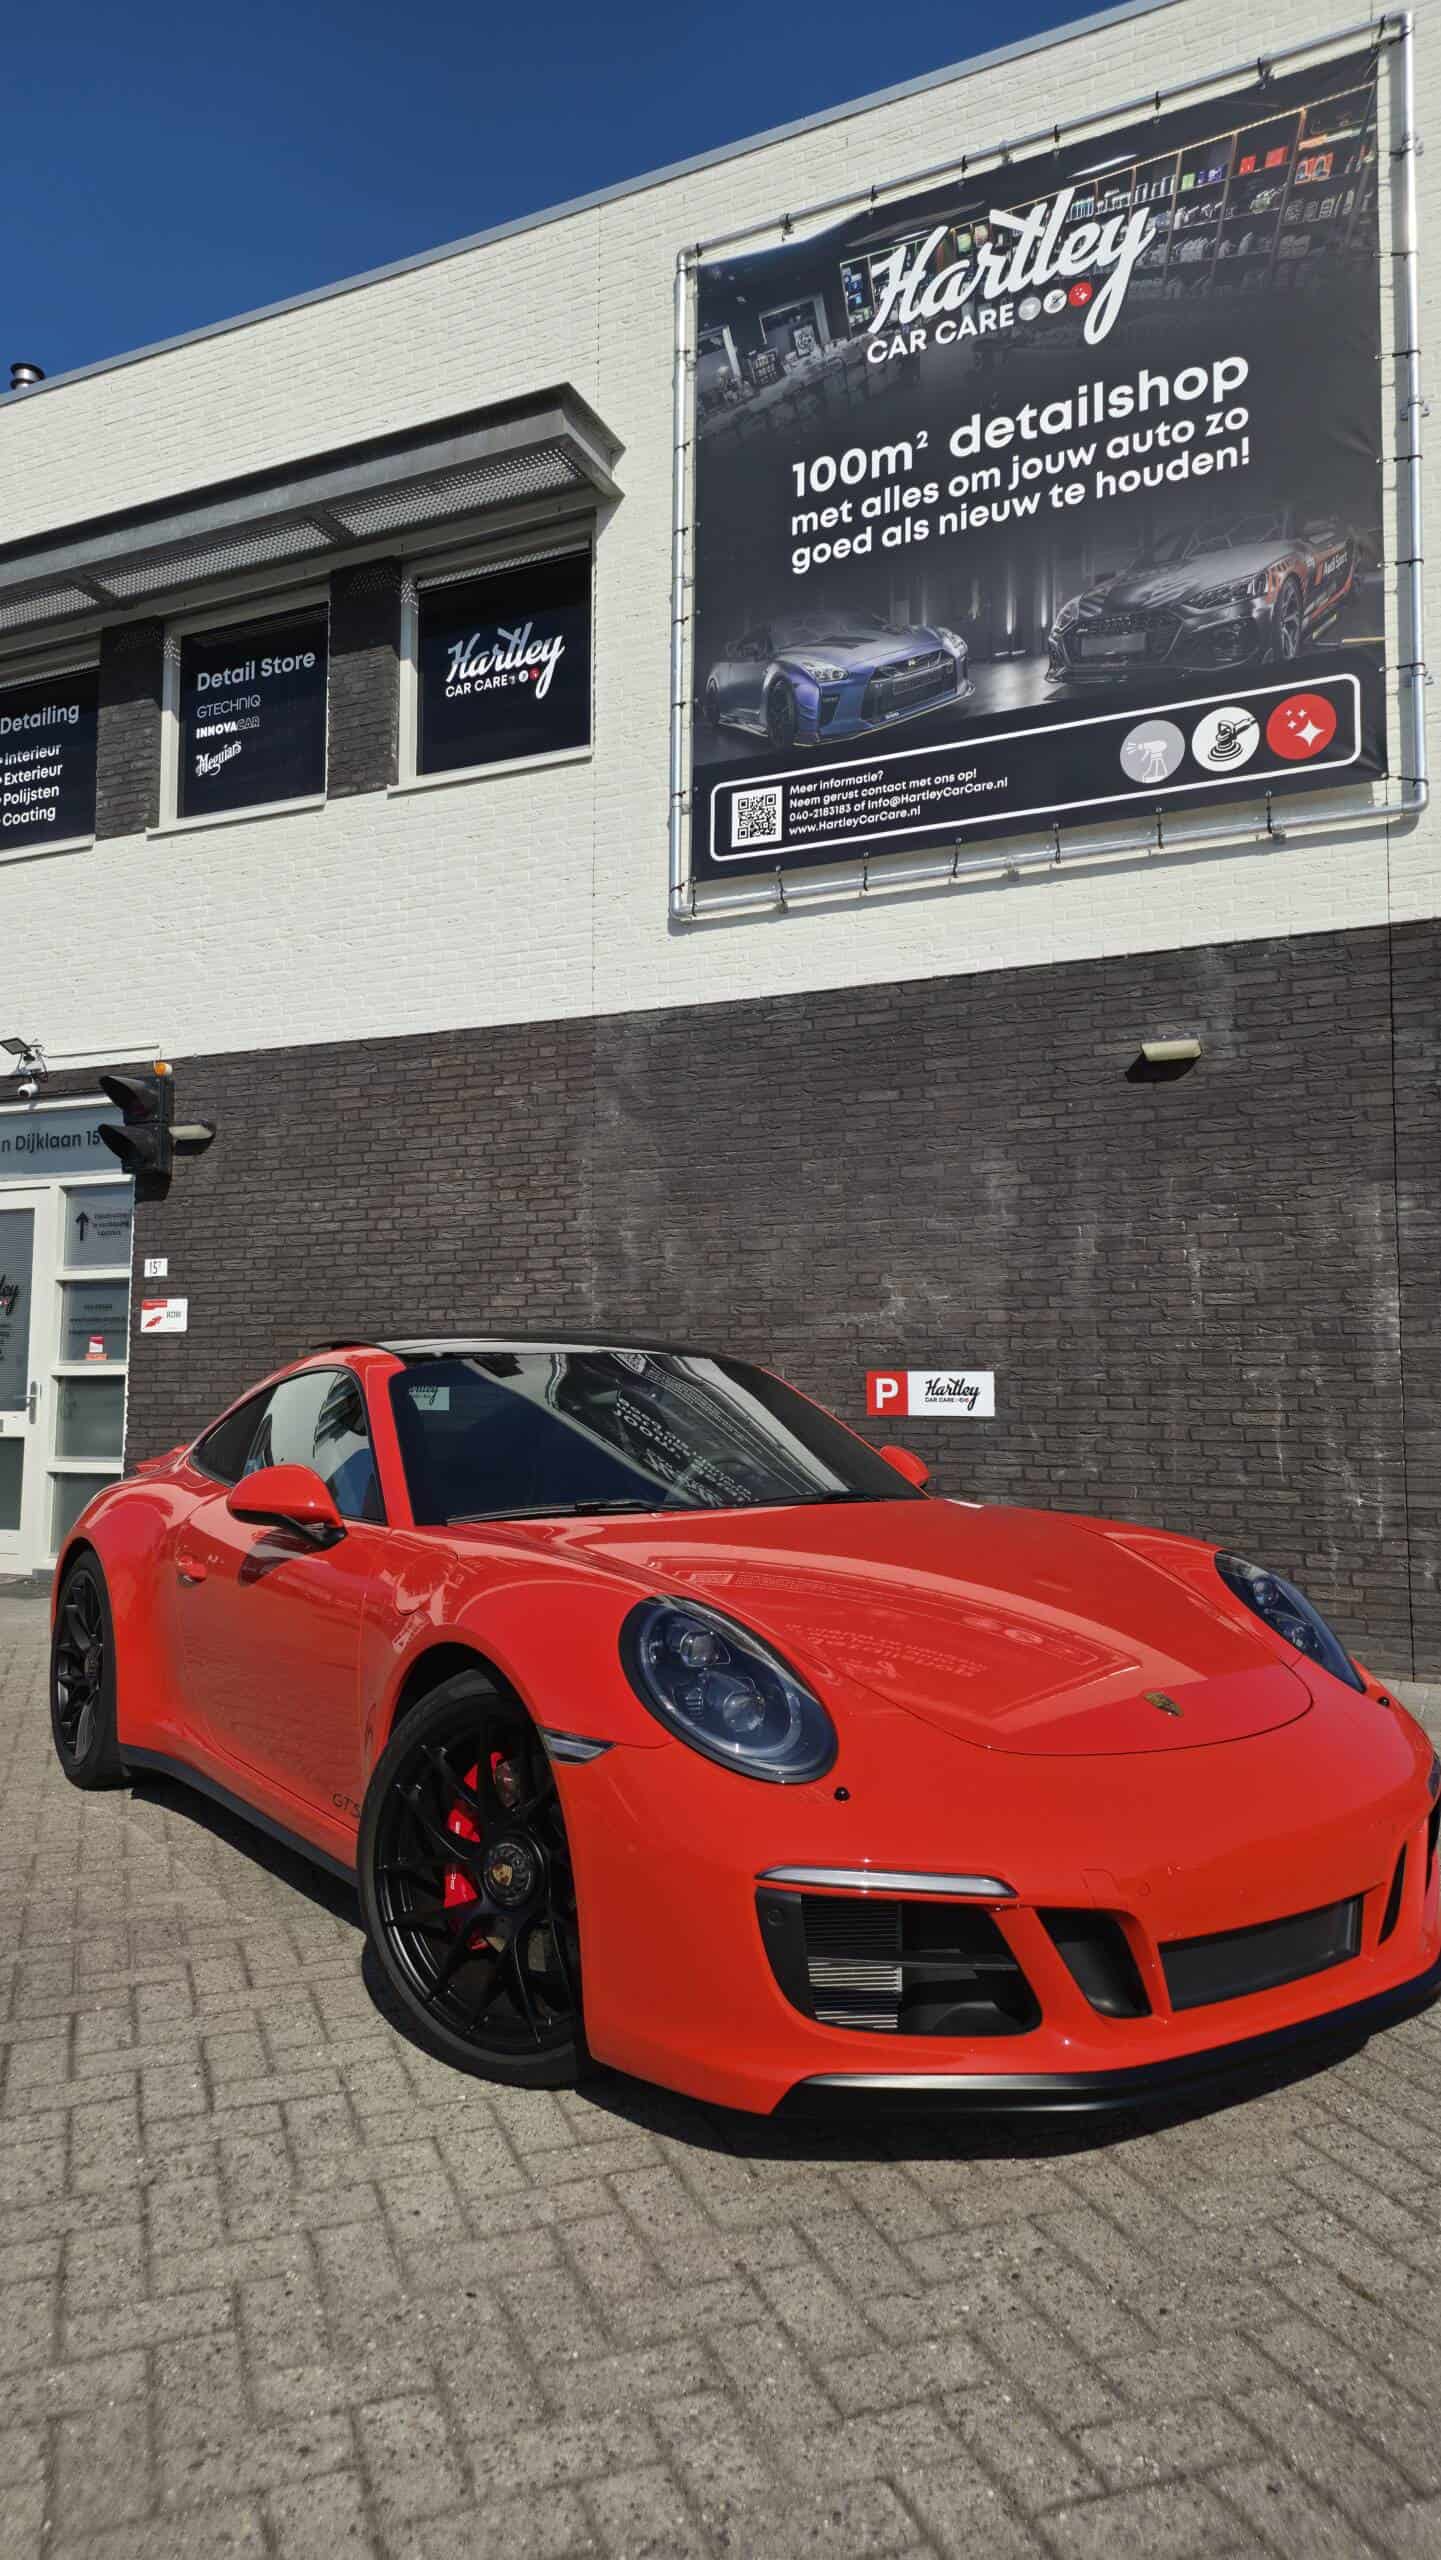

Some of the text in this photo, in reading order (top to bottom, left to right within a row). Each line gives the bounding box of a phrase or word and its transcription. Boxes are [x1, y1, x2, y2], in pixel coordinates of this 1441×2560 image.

[867, 187, 1157, 345] Hartley
[867, 303, 1015, 364] CAR CARE
[949, 356, 1249, 458] detailshop
[791, 407, 1249, 536] met alles om jouw auto zo
[791, 436, 1250, 574] goed als nieuw te houden!
[197, 652, 316, 692] Detail Store
[446, 621, 565, 699] Hartley
[445, 674, 508, 697] CAR CARE
[0, 704, 80, 735] Detailing
[196, 716, 260, 739] INNOVACAR
[4, 744, 62, 766] Interieur
[4, 764, 63, 786] Exterieur
[790, 768, 977, 809] Neem gerust contact met ons op!
[790, 783, 818, 796] Meer
[3, 785, 60, 806] Polijsten
[2, 806, 56, 826] Coating
[789, 803, 852, 822] 040-2183183
[854, 802, 866, 812] of
[789, 805, 921, 836] www.HartleyCarCare.nl
[15, 1131, 82, 1154] Dijklaan
[875, 1377, 899, 1409] P
[925, 1377, 980, 1411] Hartley
[331, 1792, 361, 1818] GTS
